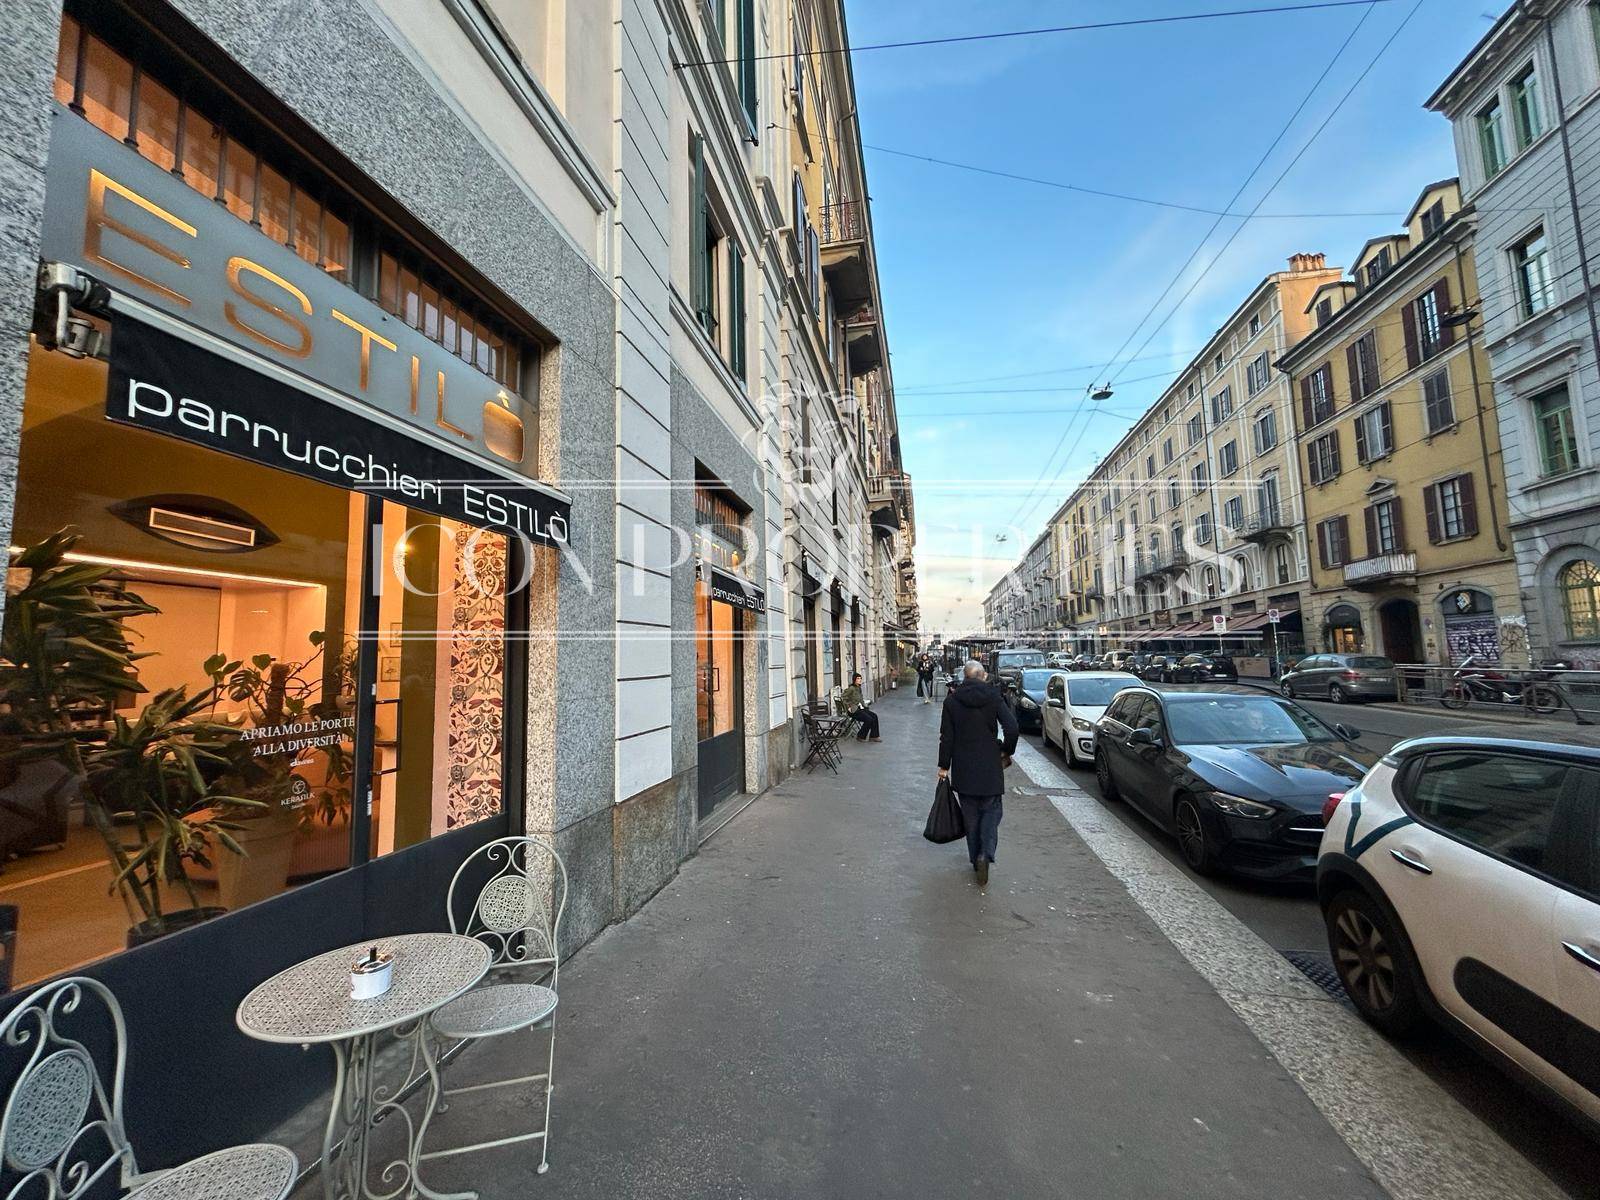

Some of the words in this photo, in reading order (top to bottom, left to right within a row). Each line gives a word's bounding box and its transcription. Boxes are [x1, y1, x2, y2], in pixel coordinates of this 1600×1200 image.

[128, 378, 442, 505] parrucchieri
[463, 483, 568, 543] ESTILÒ
[240, 723, 302, 741] APRIAMO
[304, 721, 319, 733] LE
[321, 717, 355, 730] PORTE
[253, 744, 286, 757] ALLA
[287, 731, 343, 752] DIVERSITÀ
